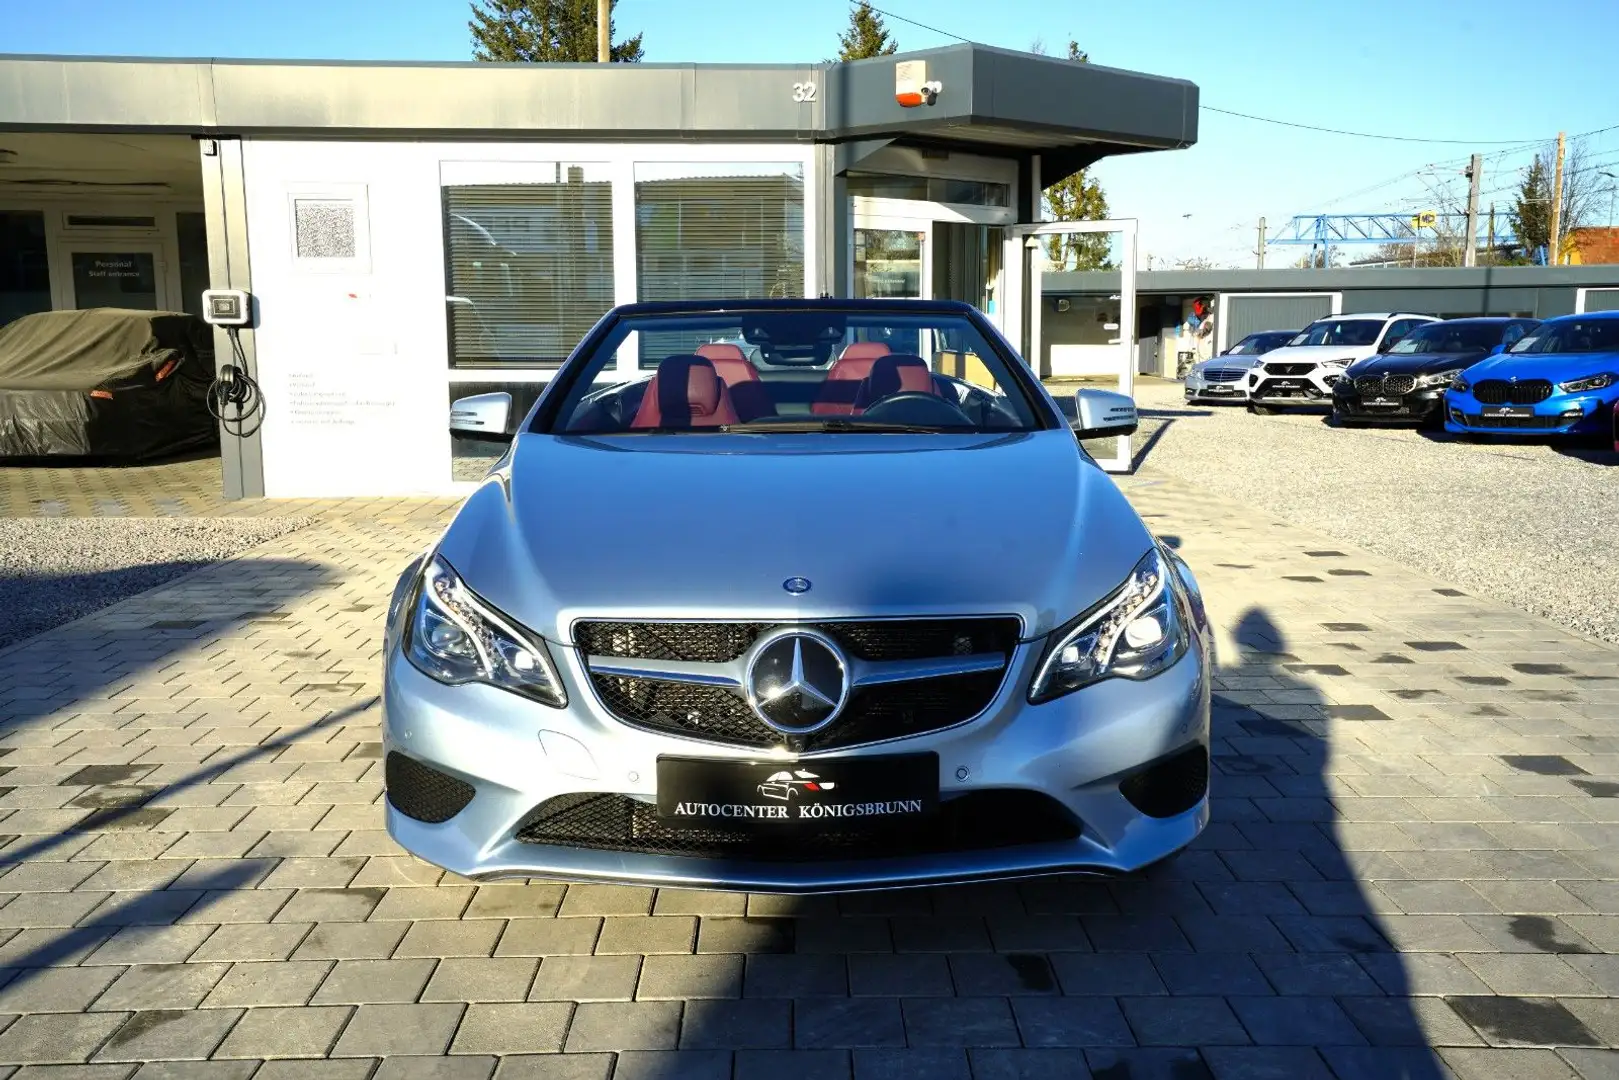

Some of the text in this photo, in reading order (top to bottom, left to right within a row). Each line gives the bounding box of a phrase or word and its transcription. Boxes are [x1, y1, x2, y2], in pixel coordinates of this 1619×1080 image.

[792, 82, 817, 103] 32
[674, 800, 922, 819] AUTOCENTER KÖNIGSBRUNN
